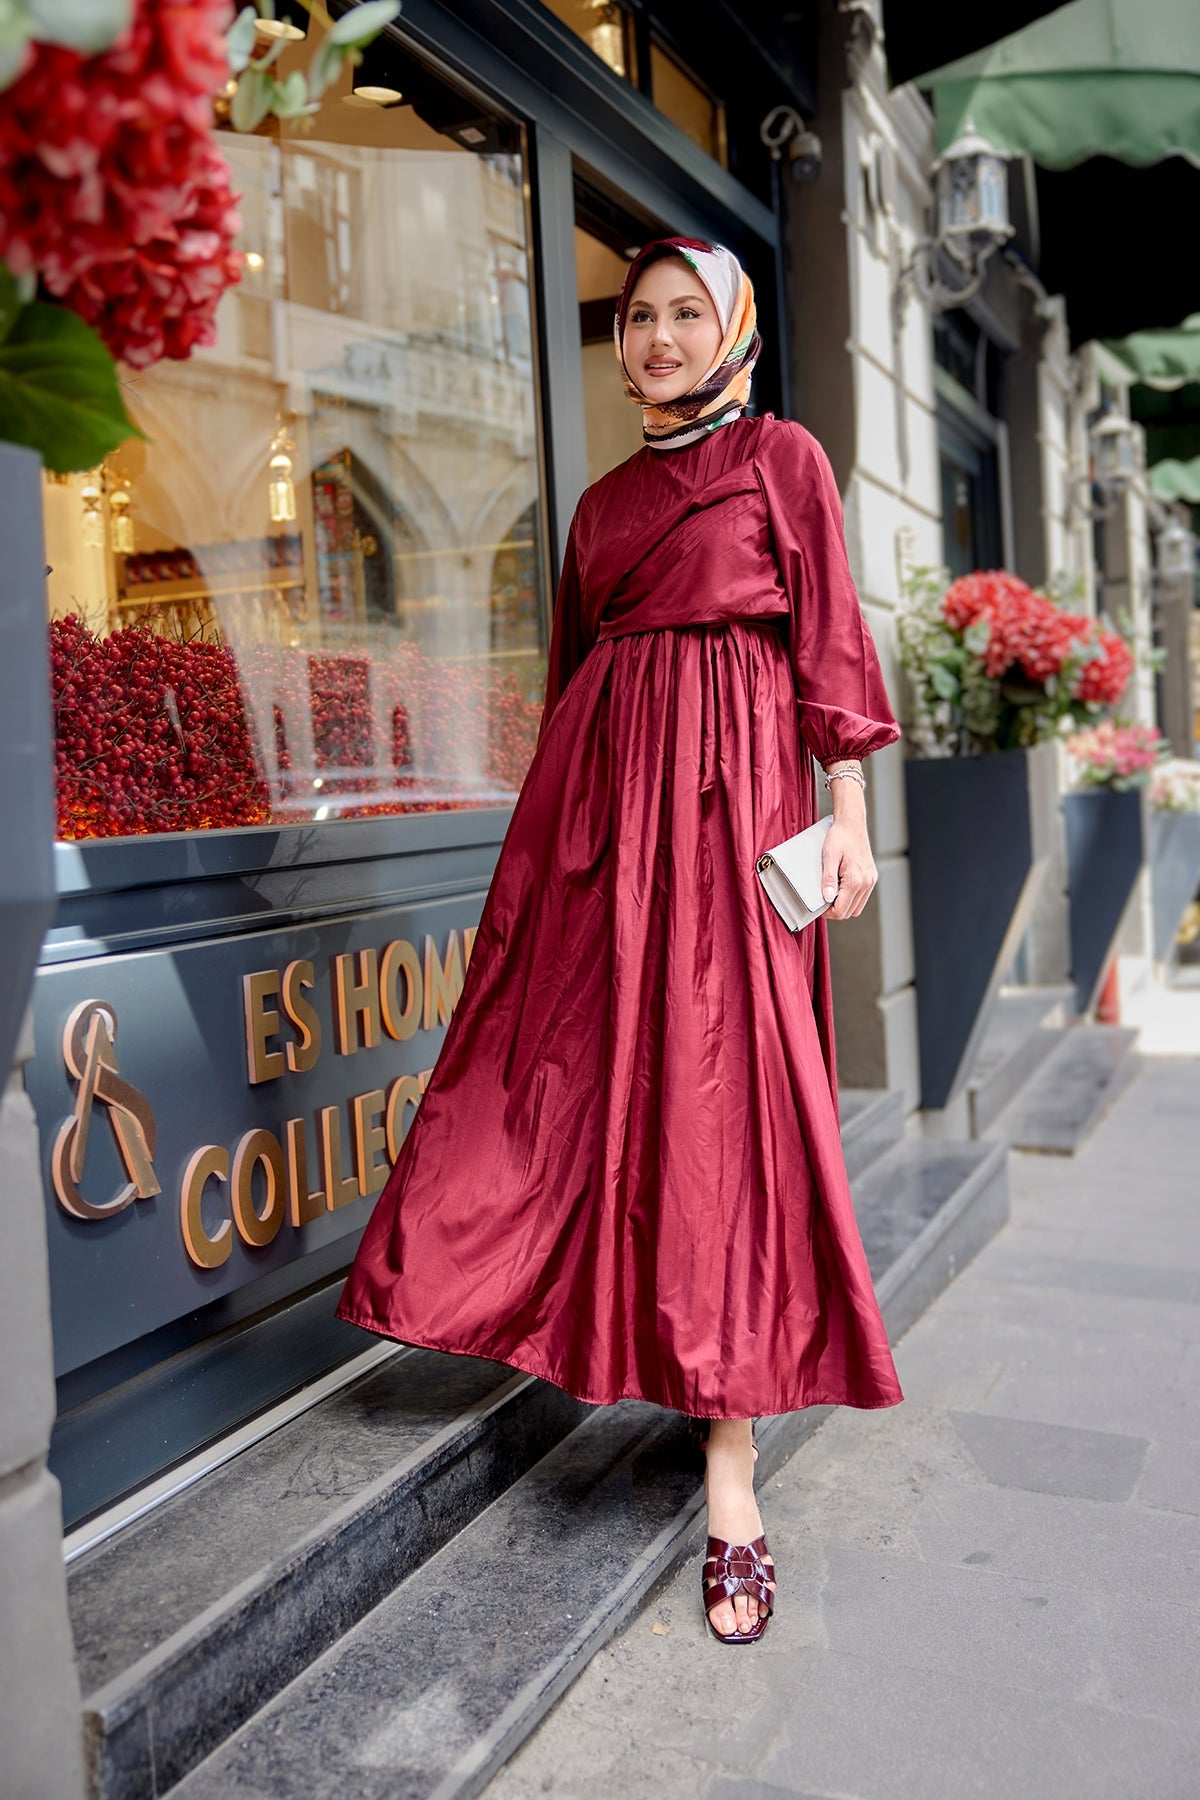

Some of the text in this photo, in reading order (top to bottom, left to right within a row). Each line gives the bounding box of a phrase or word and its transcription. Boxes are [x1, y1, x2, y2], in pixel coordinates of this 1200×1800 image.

[243, 927, 478, 1084] ES HOM
[181, 1068, 434, 1268] COLLEC
